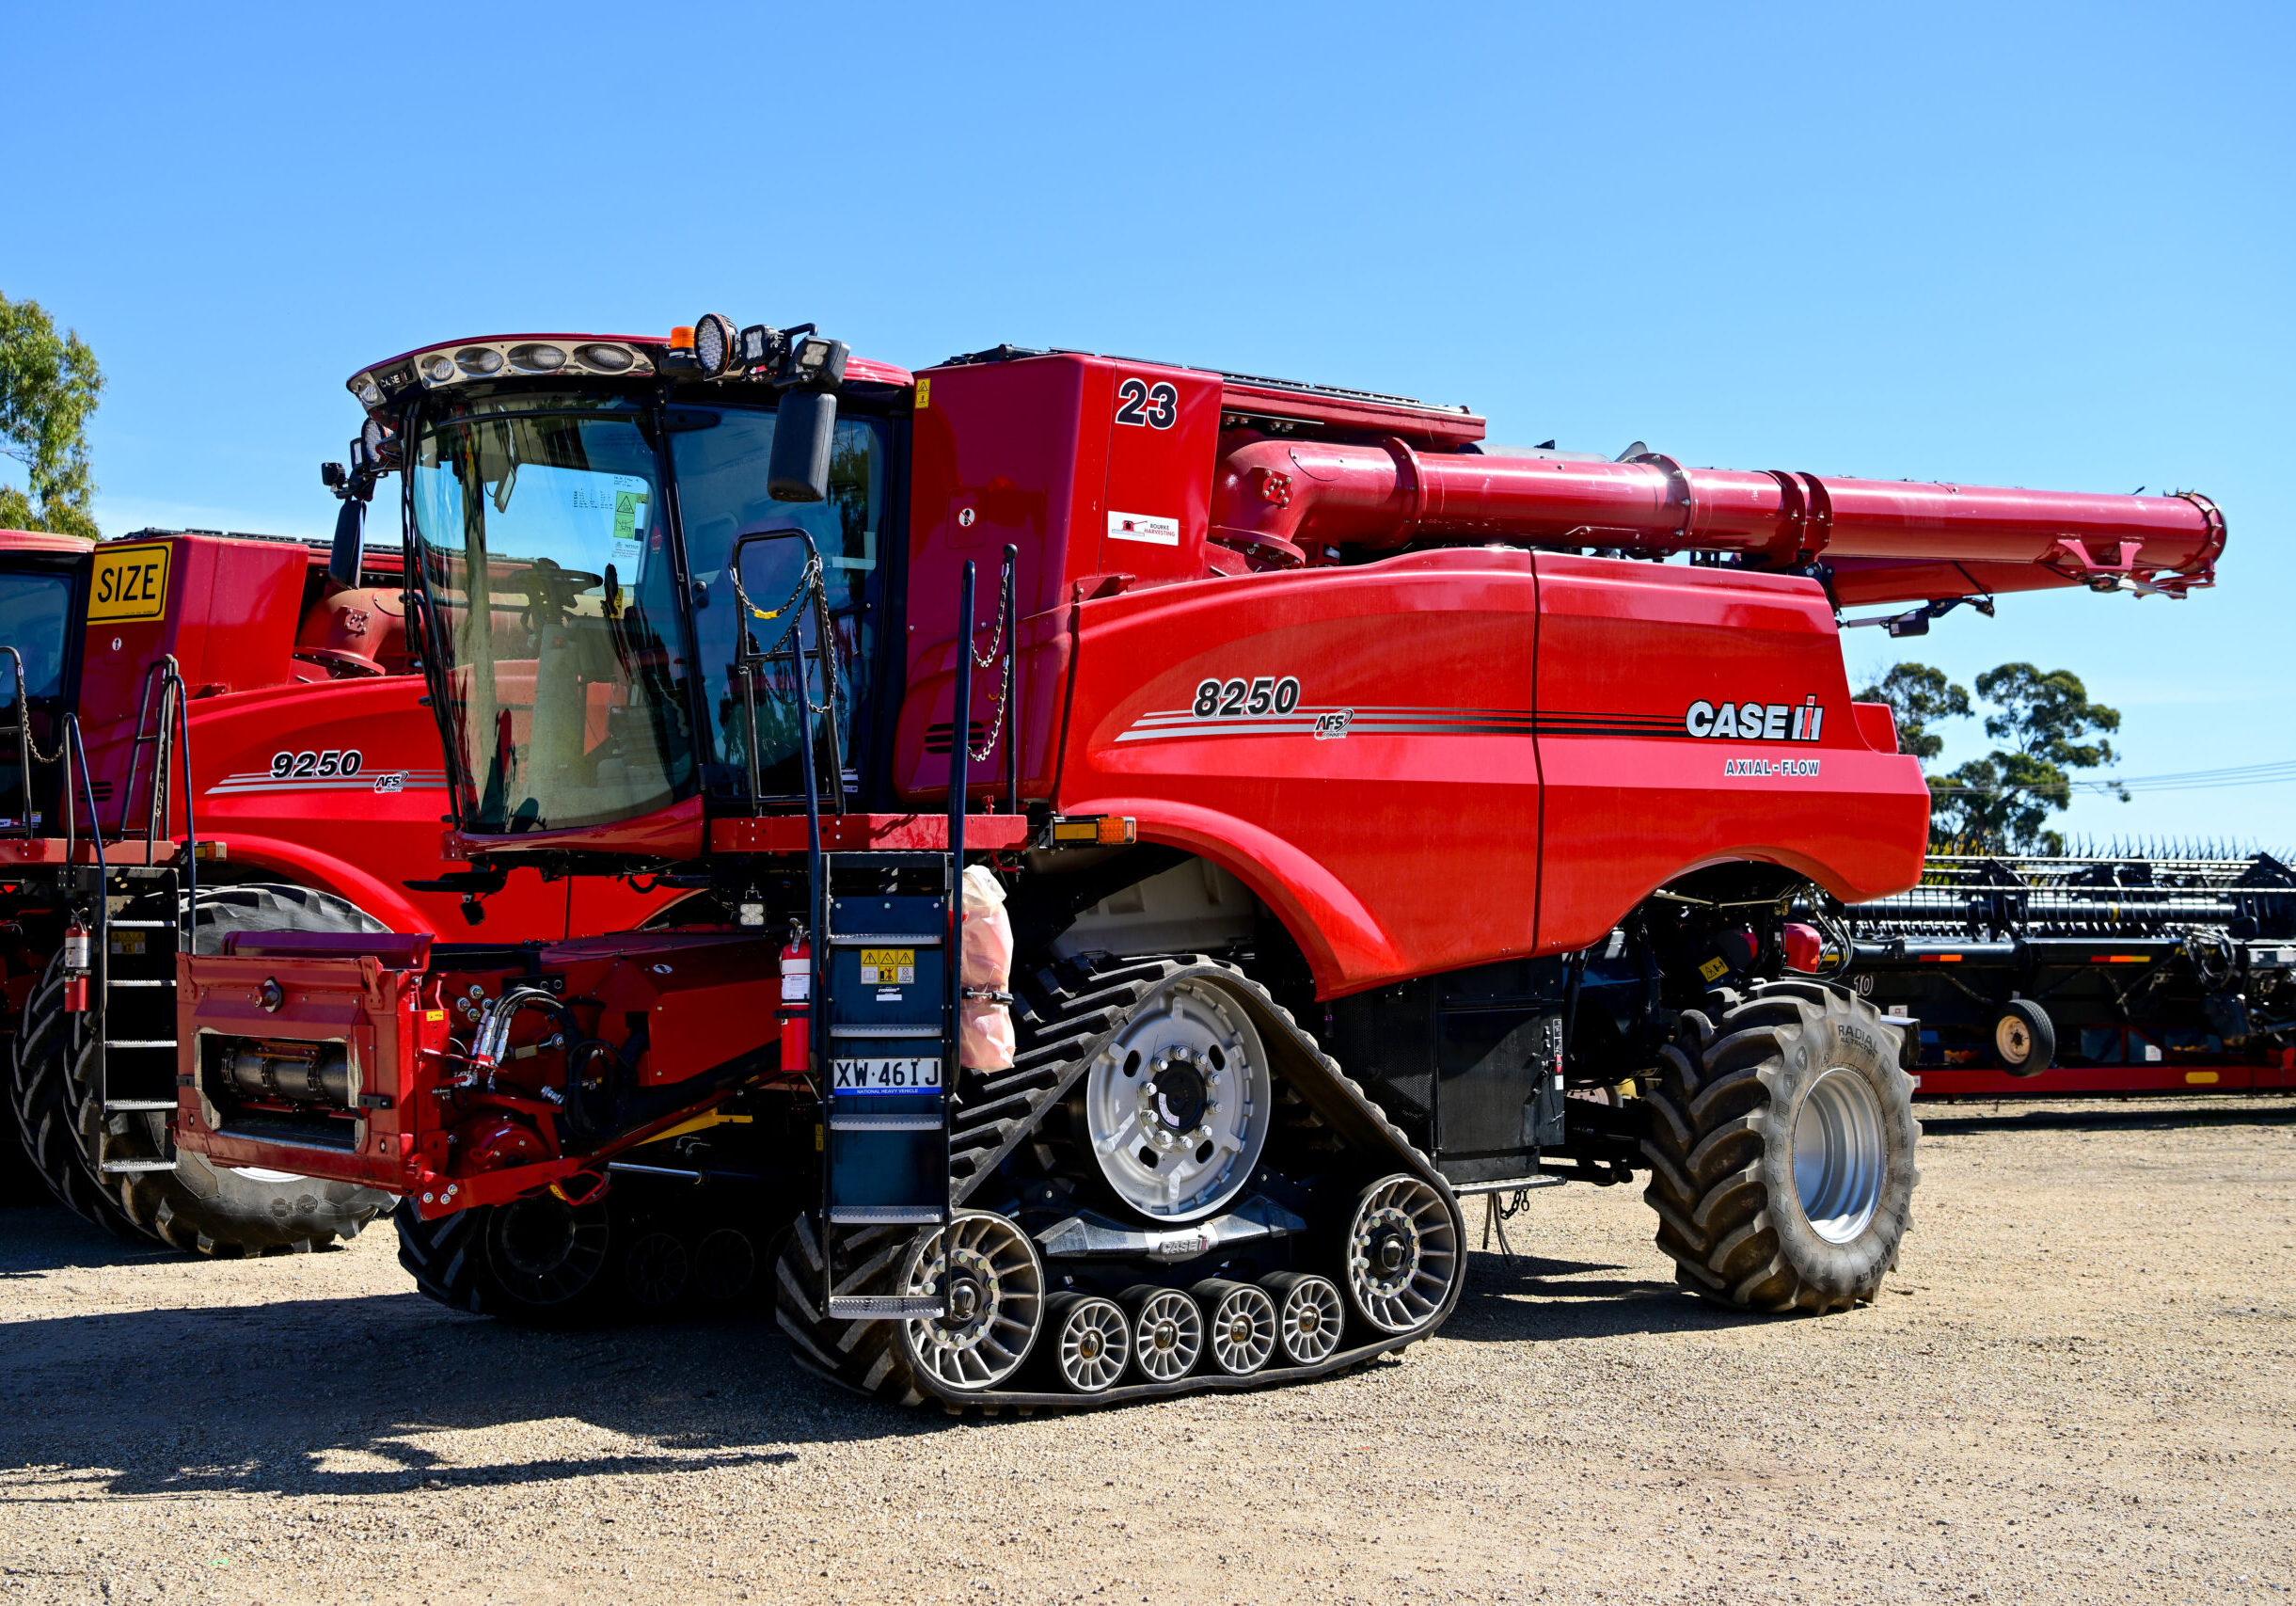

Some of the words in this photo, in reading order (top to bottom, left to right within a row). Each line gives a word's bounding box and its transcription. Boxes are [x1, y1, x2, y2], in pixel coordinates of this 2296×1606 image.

[1116, 378, 1178, 430] 23
[1144, 528, 1176, 537] HARVESTING
[97, 564, 158, 602] SIZE
[1193, 676, 1300, 719] 8250
[1315, 712, 1346, 731] AFS
[1686, 699, 1788, 740] CASE
[270, 750, 363, 779] 9250
[1724, 759, 1821, 777] AXIAL-FLOW
[374, 775, 402, 787] AFS
[1854, 974, 1874, 996] 10
[1838, 1025, 1878, 1055] RADIAL
[1160, 1239, 1200, 1254] CASE
